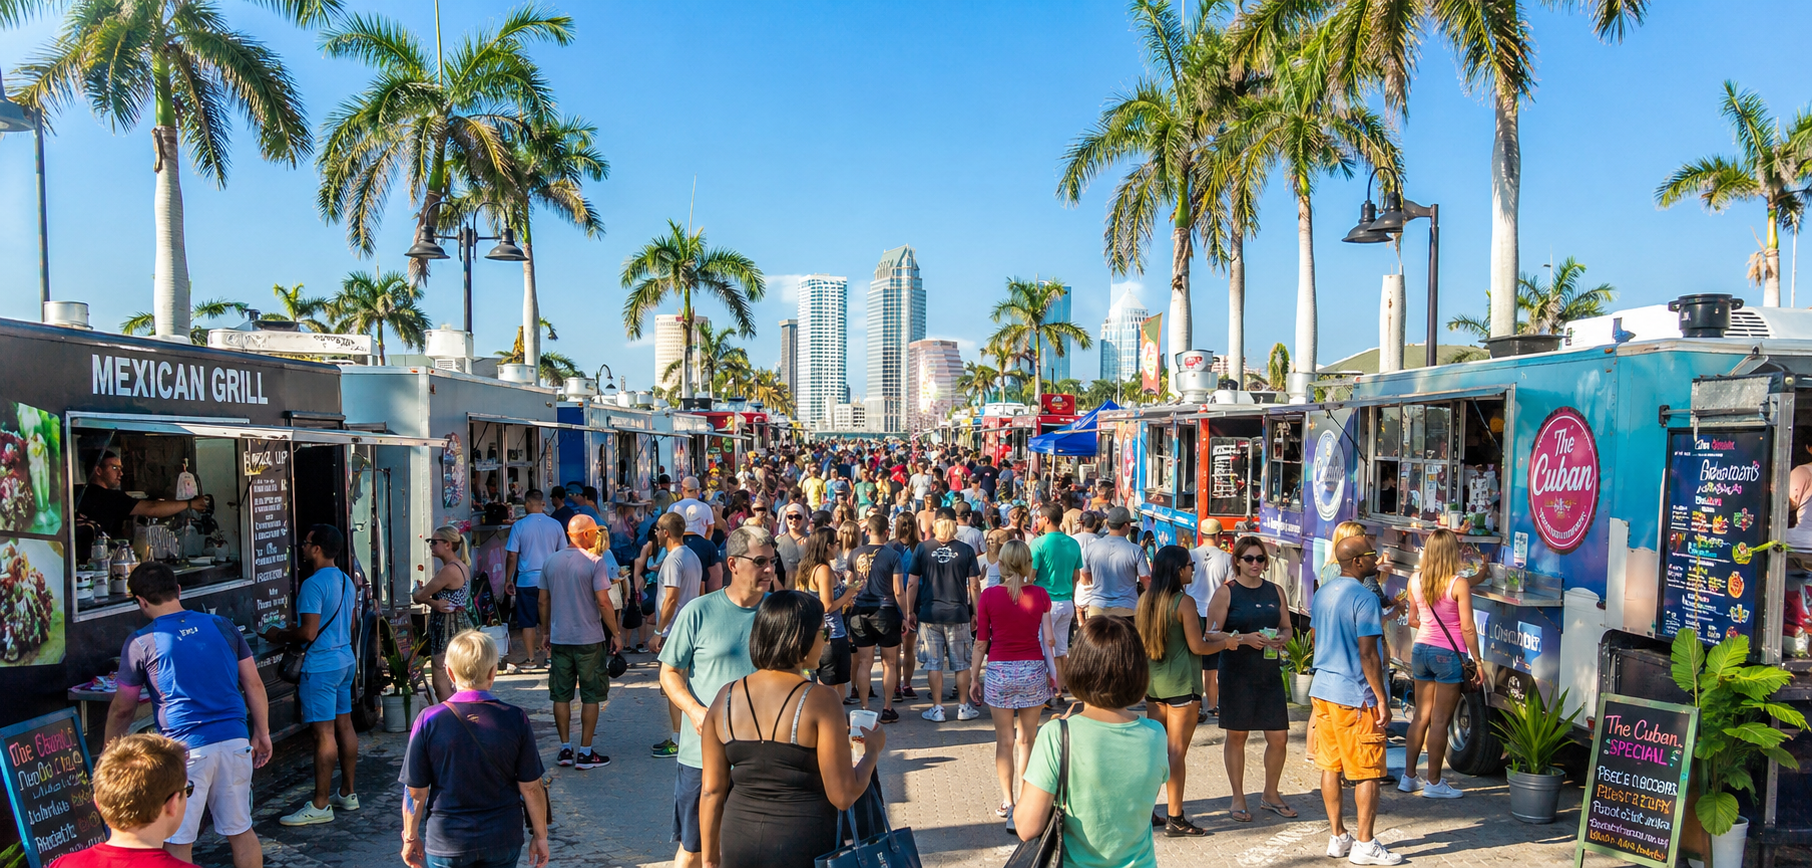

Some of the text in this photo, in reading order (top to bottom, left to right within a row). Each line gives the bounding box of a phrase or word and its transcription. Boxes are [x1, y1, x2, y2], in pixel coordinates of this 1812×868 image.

[91, 353, 269, 405] MEXICAN GRILL
[1554, 427, 1575, 457] The
[1532, 452, 1595, 496] Cuban
[1605, 715, 1678, 747] The Cuban
